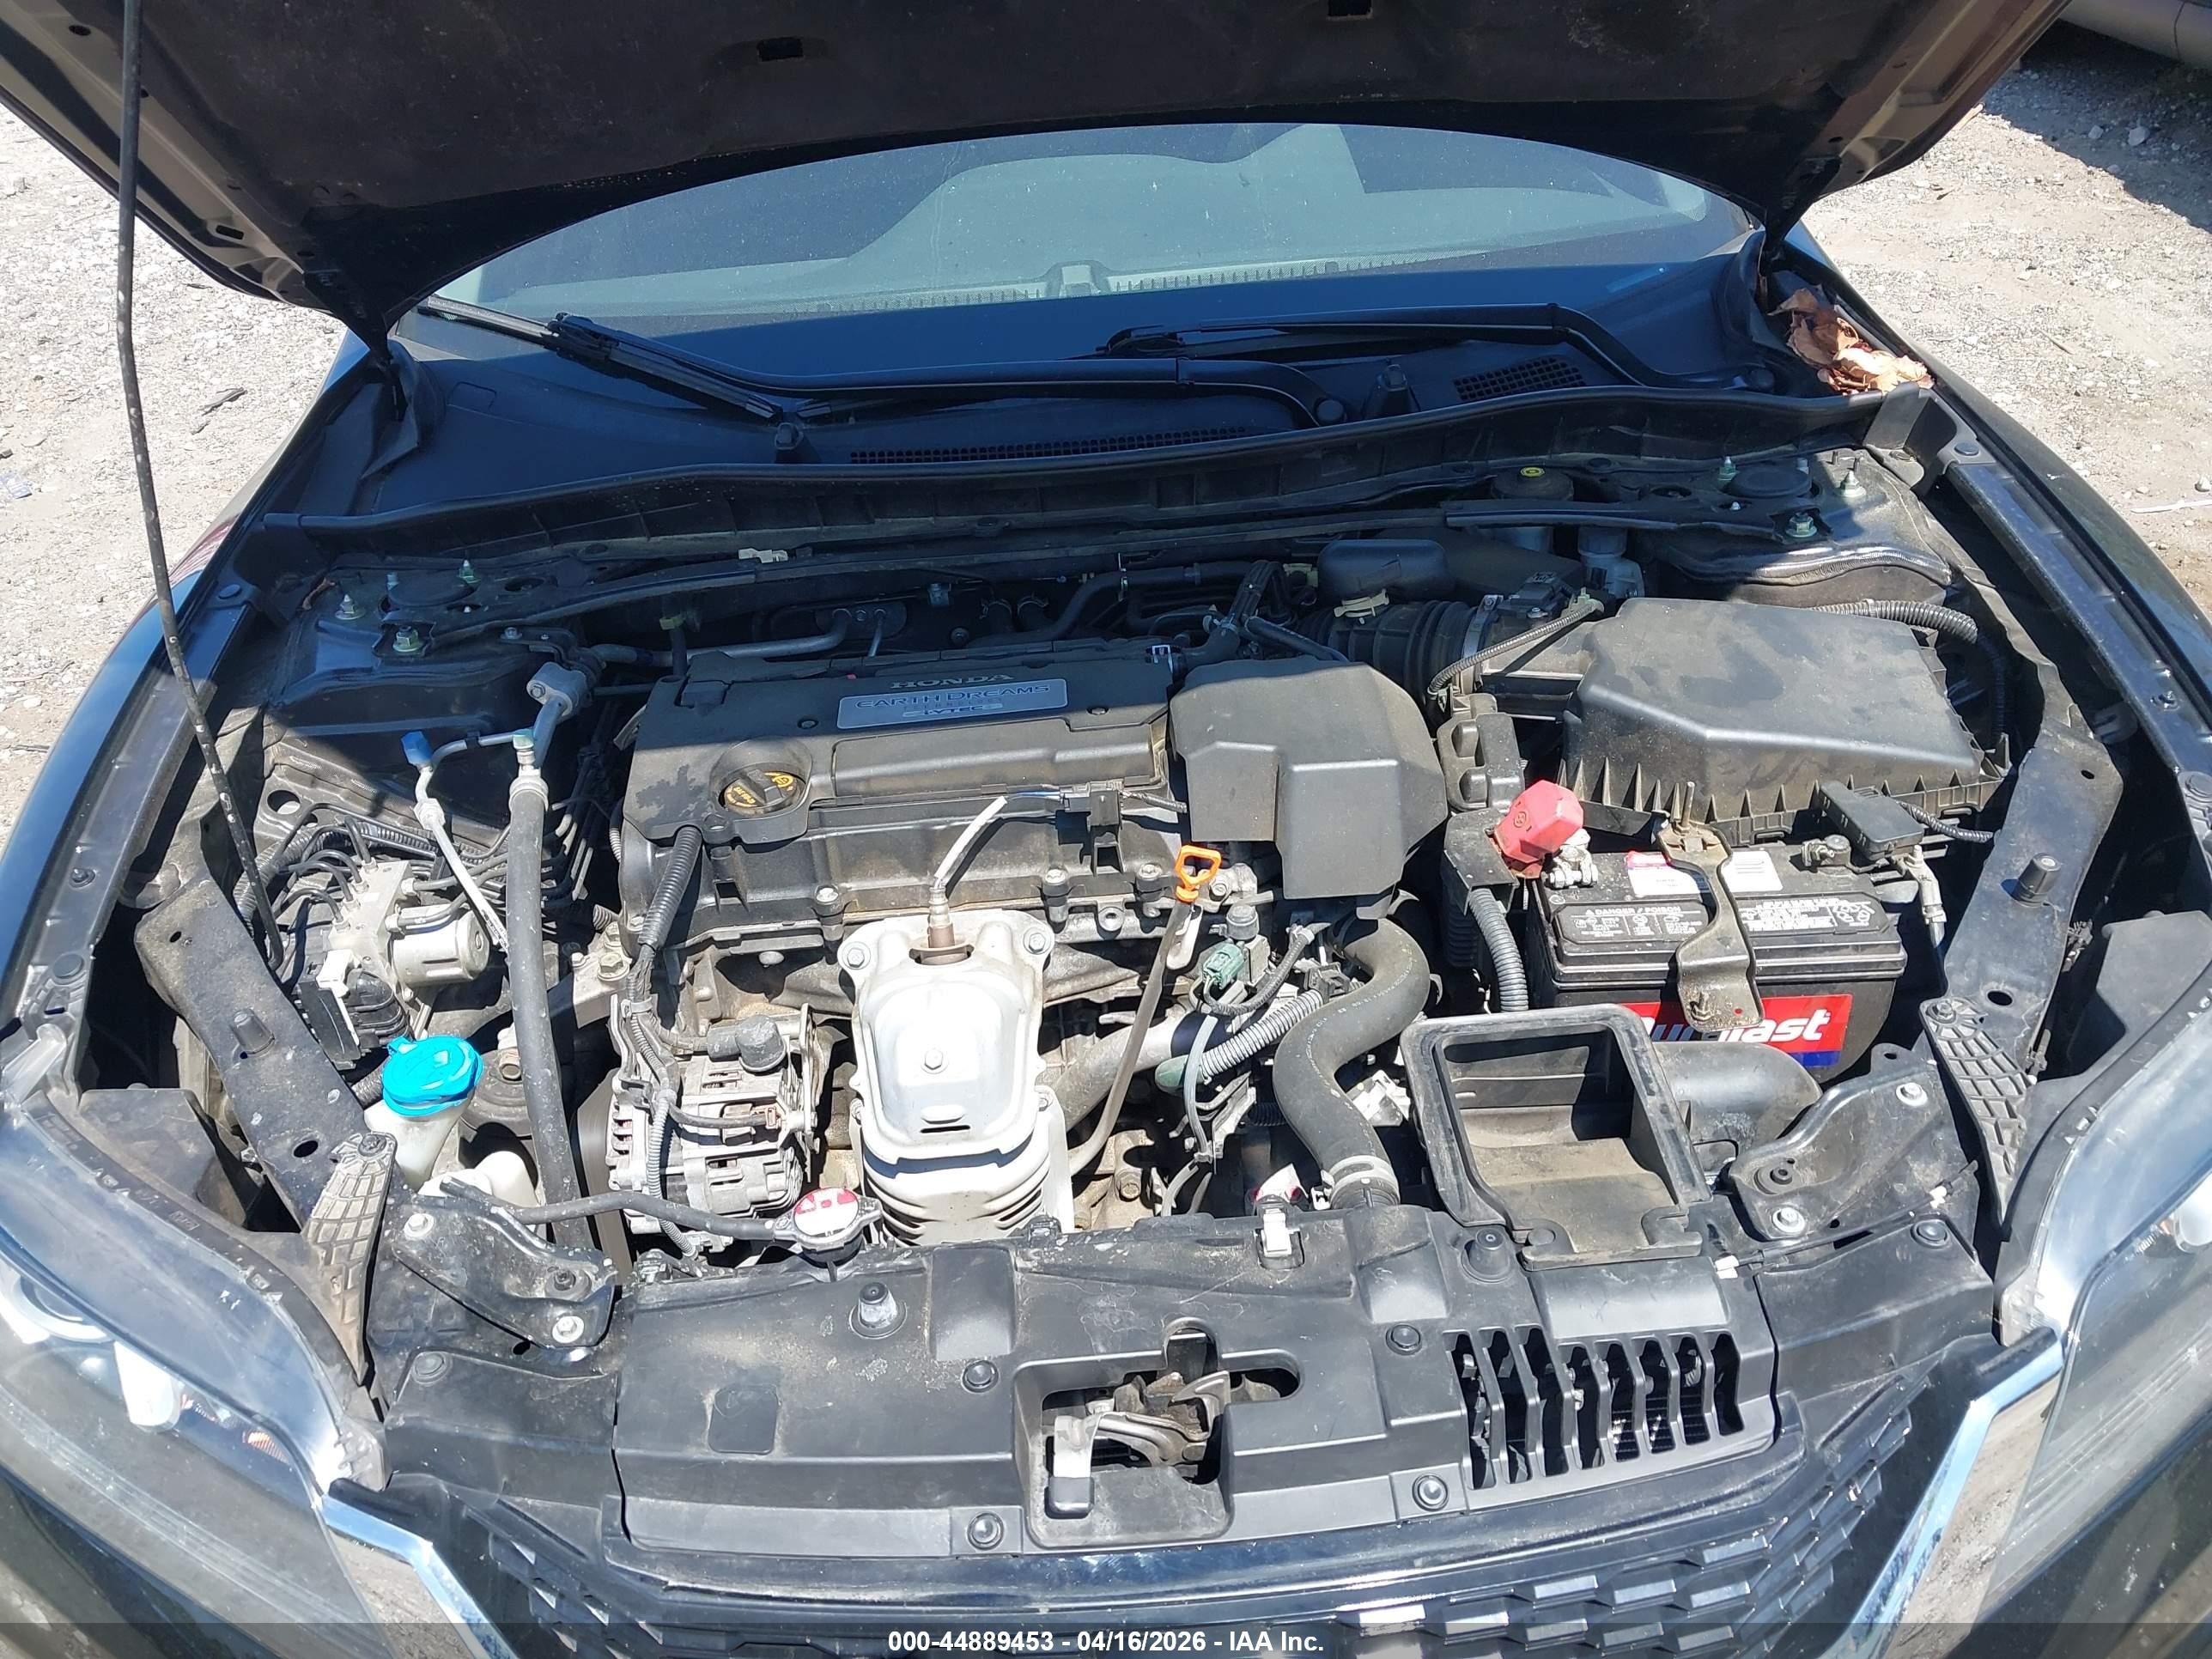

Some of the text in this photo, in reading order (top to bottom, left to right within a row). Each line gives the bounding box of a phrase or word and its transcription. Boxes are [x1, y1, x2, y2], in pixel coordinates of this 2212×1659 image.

[890, 674, 1016, 689] HONDA
[855, 694, 941, 708] EARTH
[947, 685, 1051, 701] DREAMS
[1595, 907, 1636, 915] DANGER
[1640, 1008, 1832, 1042] uraast
